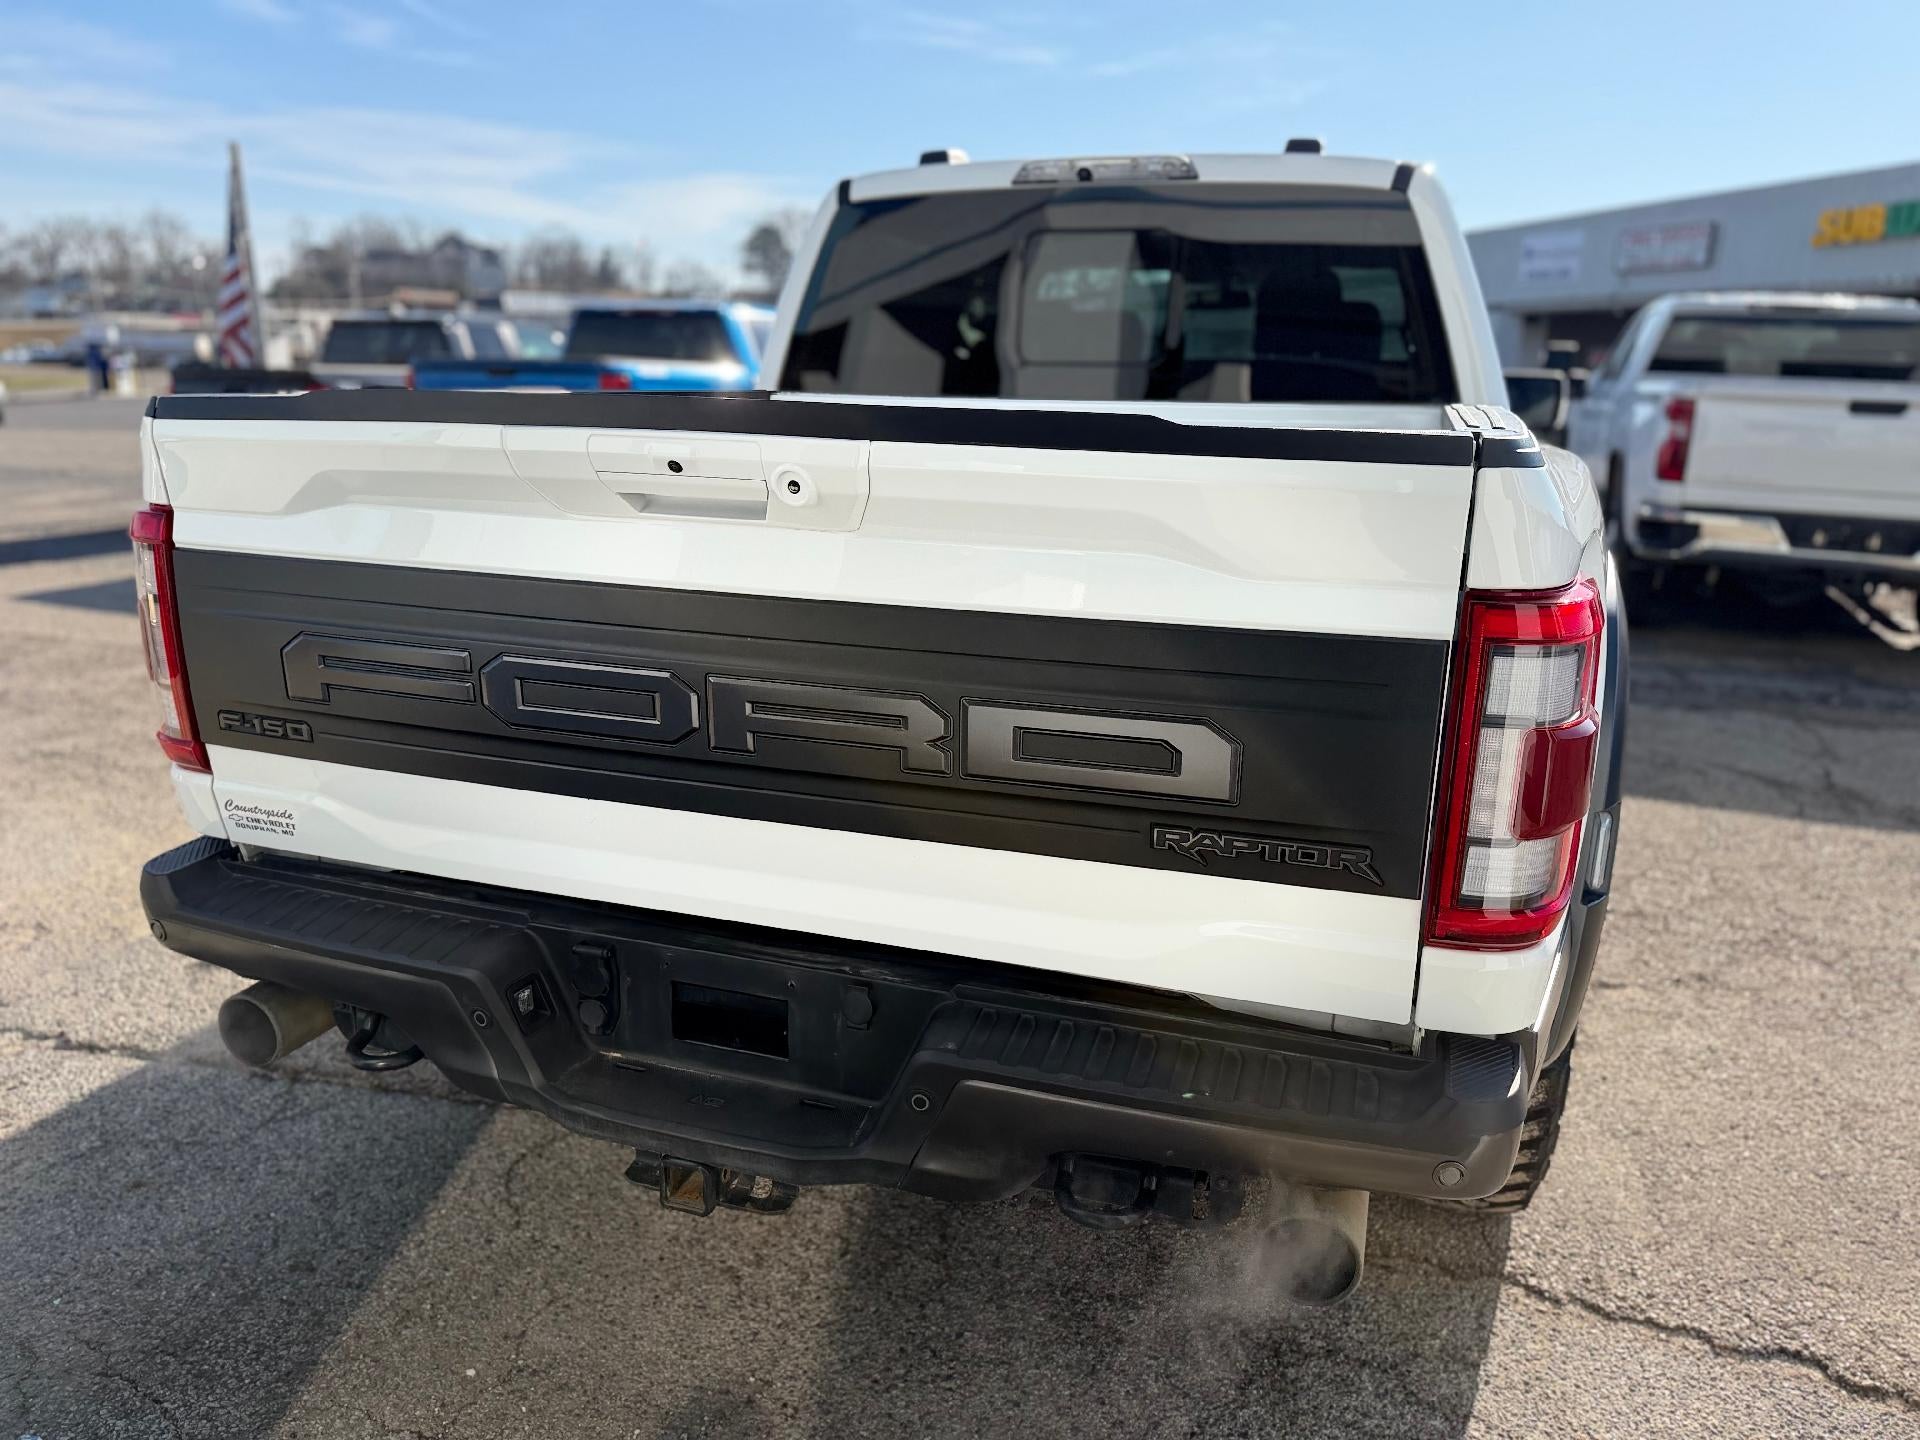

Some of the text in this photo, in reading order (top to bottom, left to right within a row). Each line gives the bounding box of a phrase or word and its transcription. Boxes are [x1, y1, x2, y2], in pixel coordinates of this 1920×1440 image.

[218, 711, 313, 742] F-150
[281, 631, 1243, 806] FORD
[224, 799, 294, 820] Countryside
[245, 816, 296, 830] CHEVROLET
[1152, 825, 1384, 887] RAPTOR
